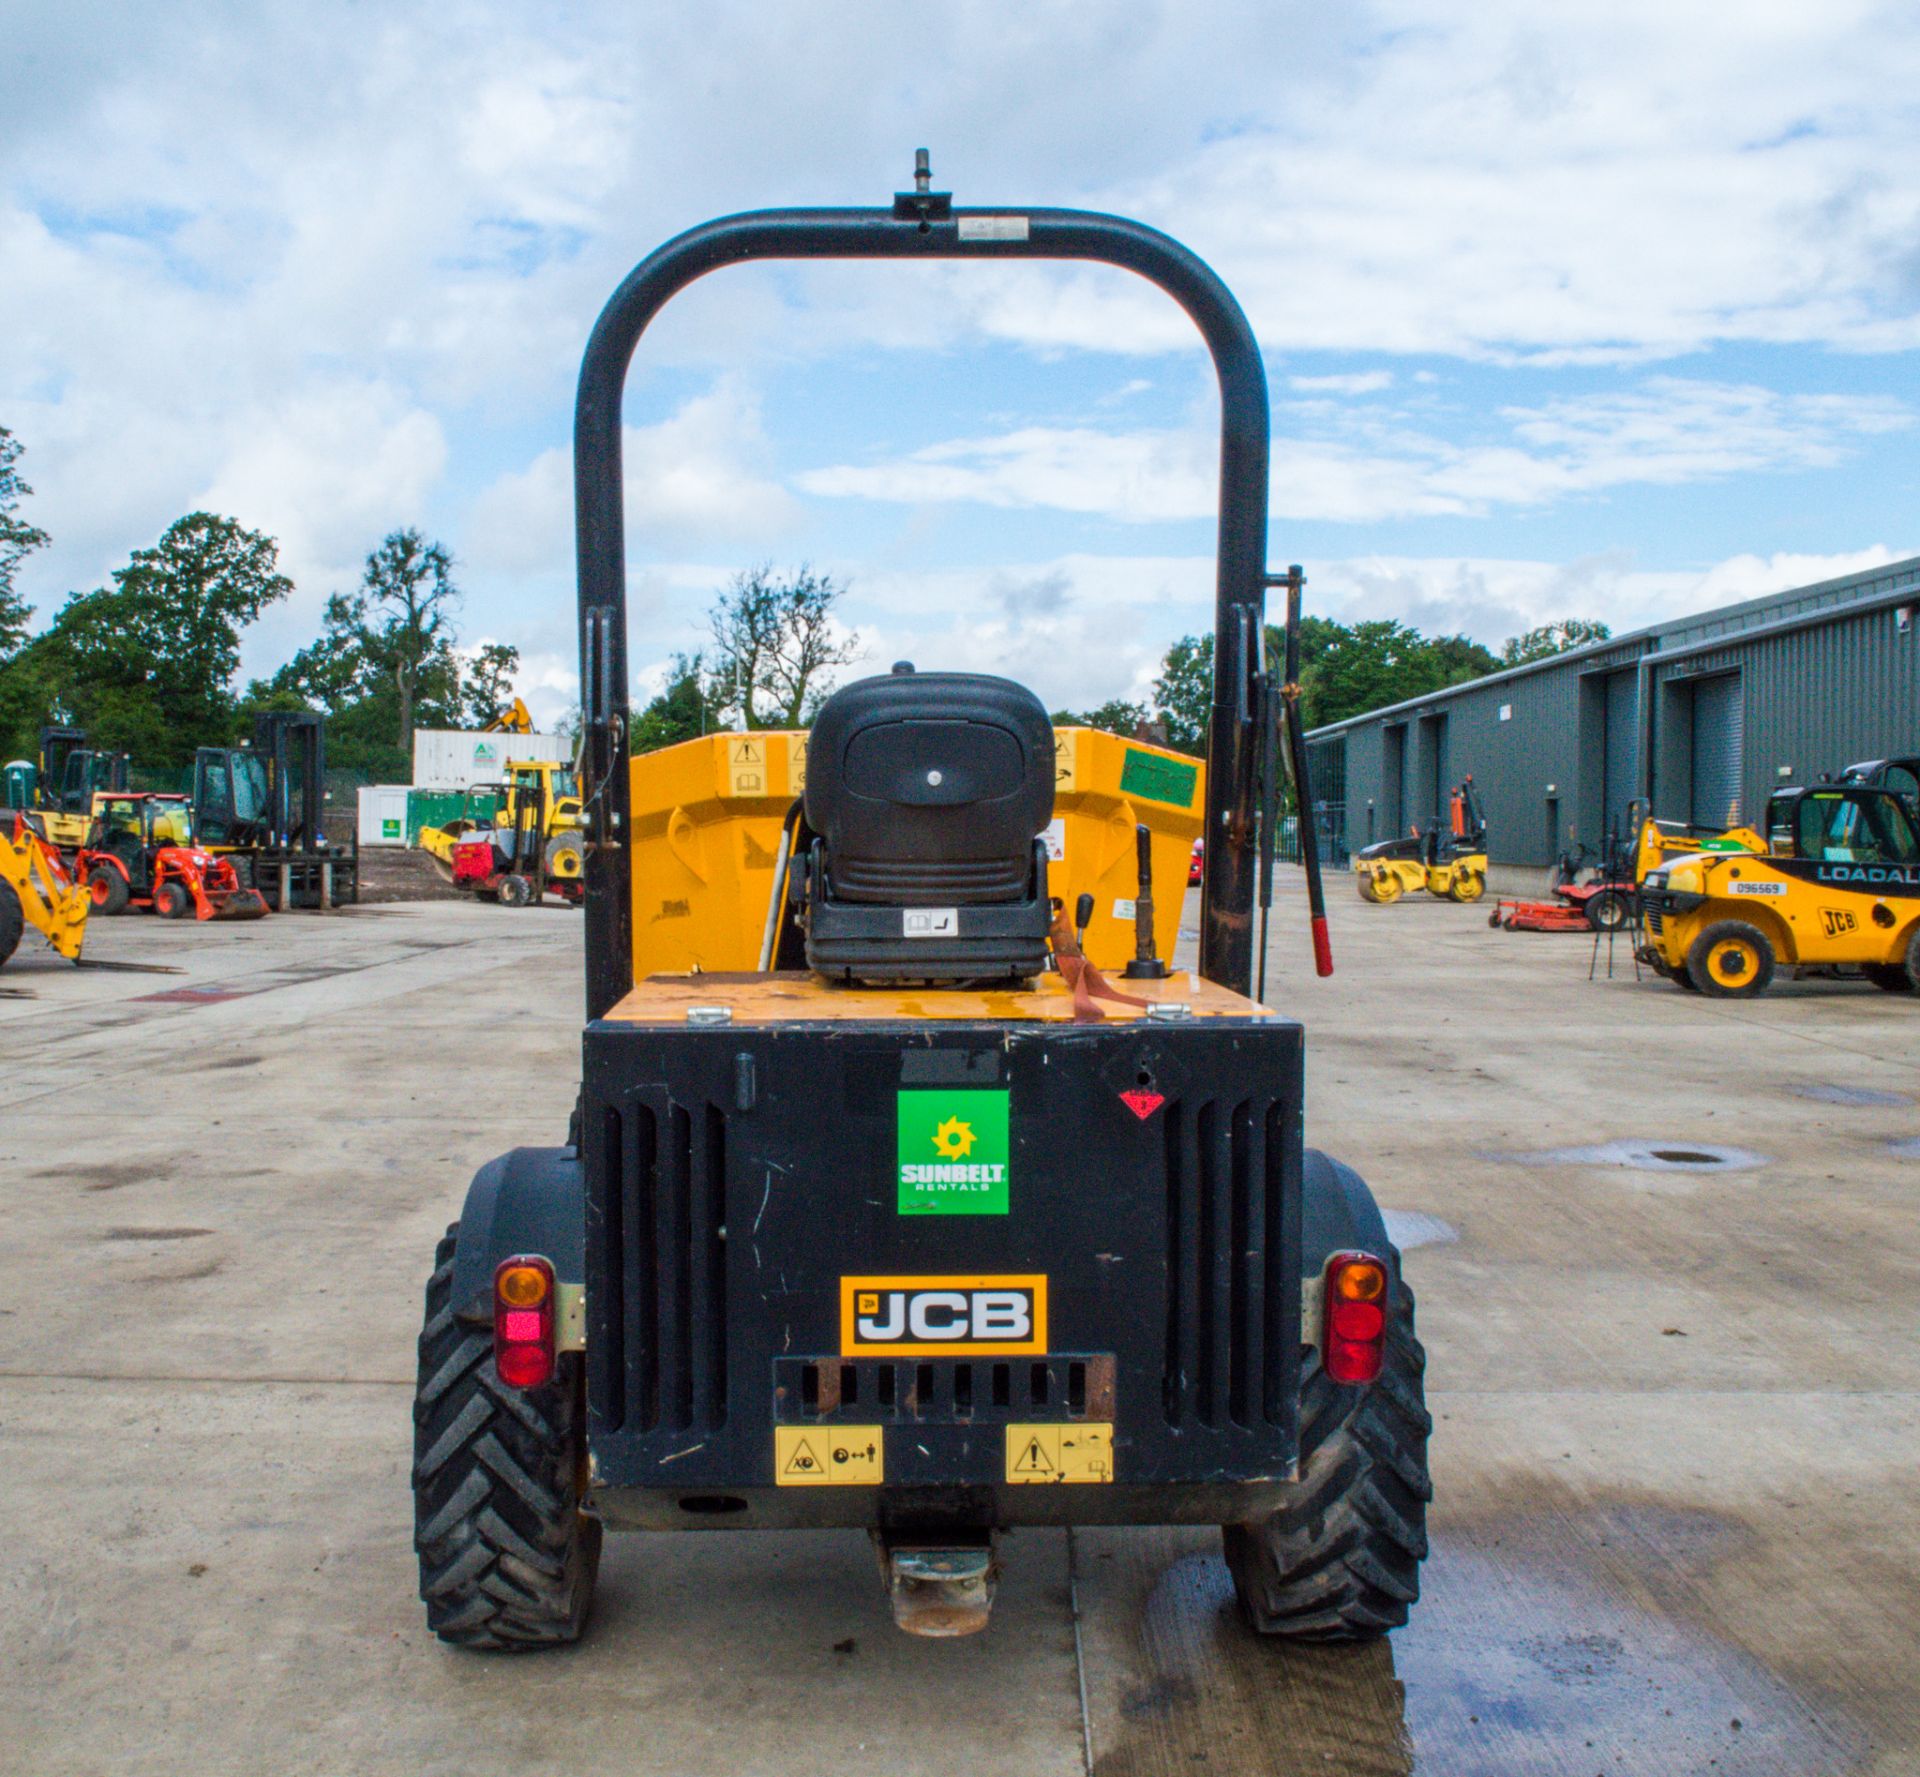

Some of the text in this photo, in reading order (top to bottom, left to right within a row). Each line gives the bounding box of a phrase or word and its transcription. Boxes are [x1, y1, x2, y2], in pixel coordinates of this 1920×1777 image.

[1817, 865, 1920, 884] LOADAL
[1824, 910, 1856, 936] JCB
[901, 1164, 1005, 1183] SUNBELT
[915, 1183, 990, 1192] RENTALS
[858, 1292, 1030, 1340] JCB
